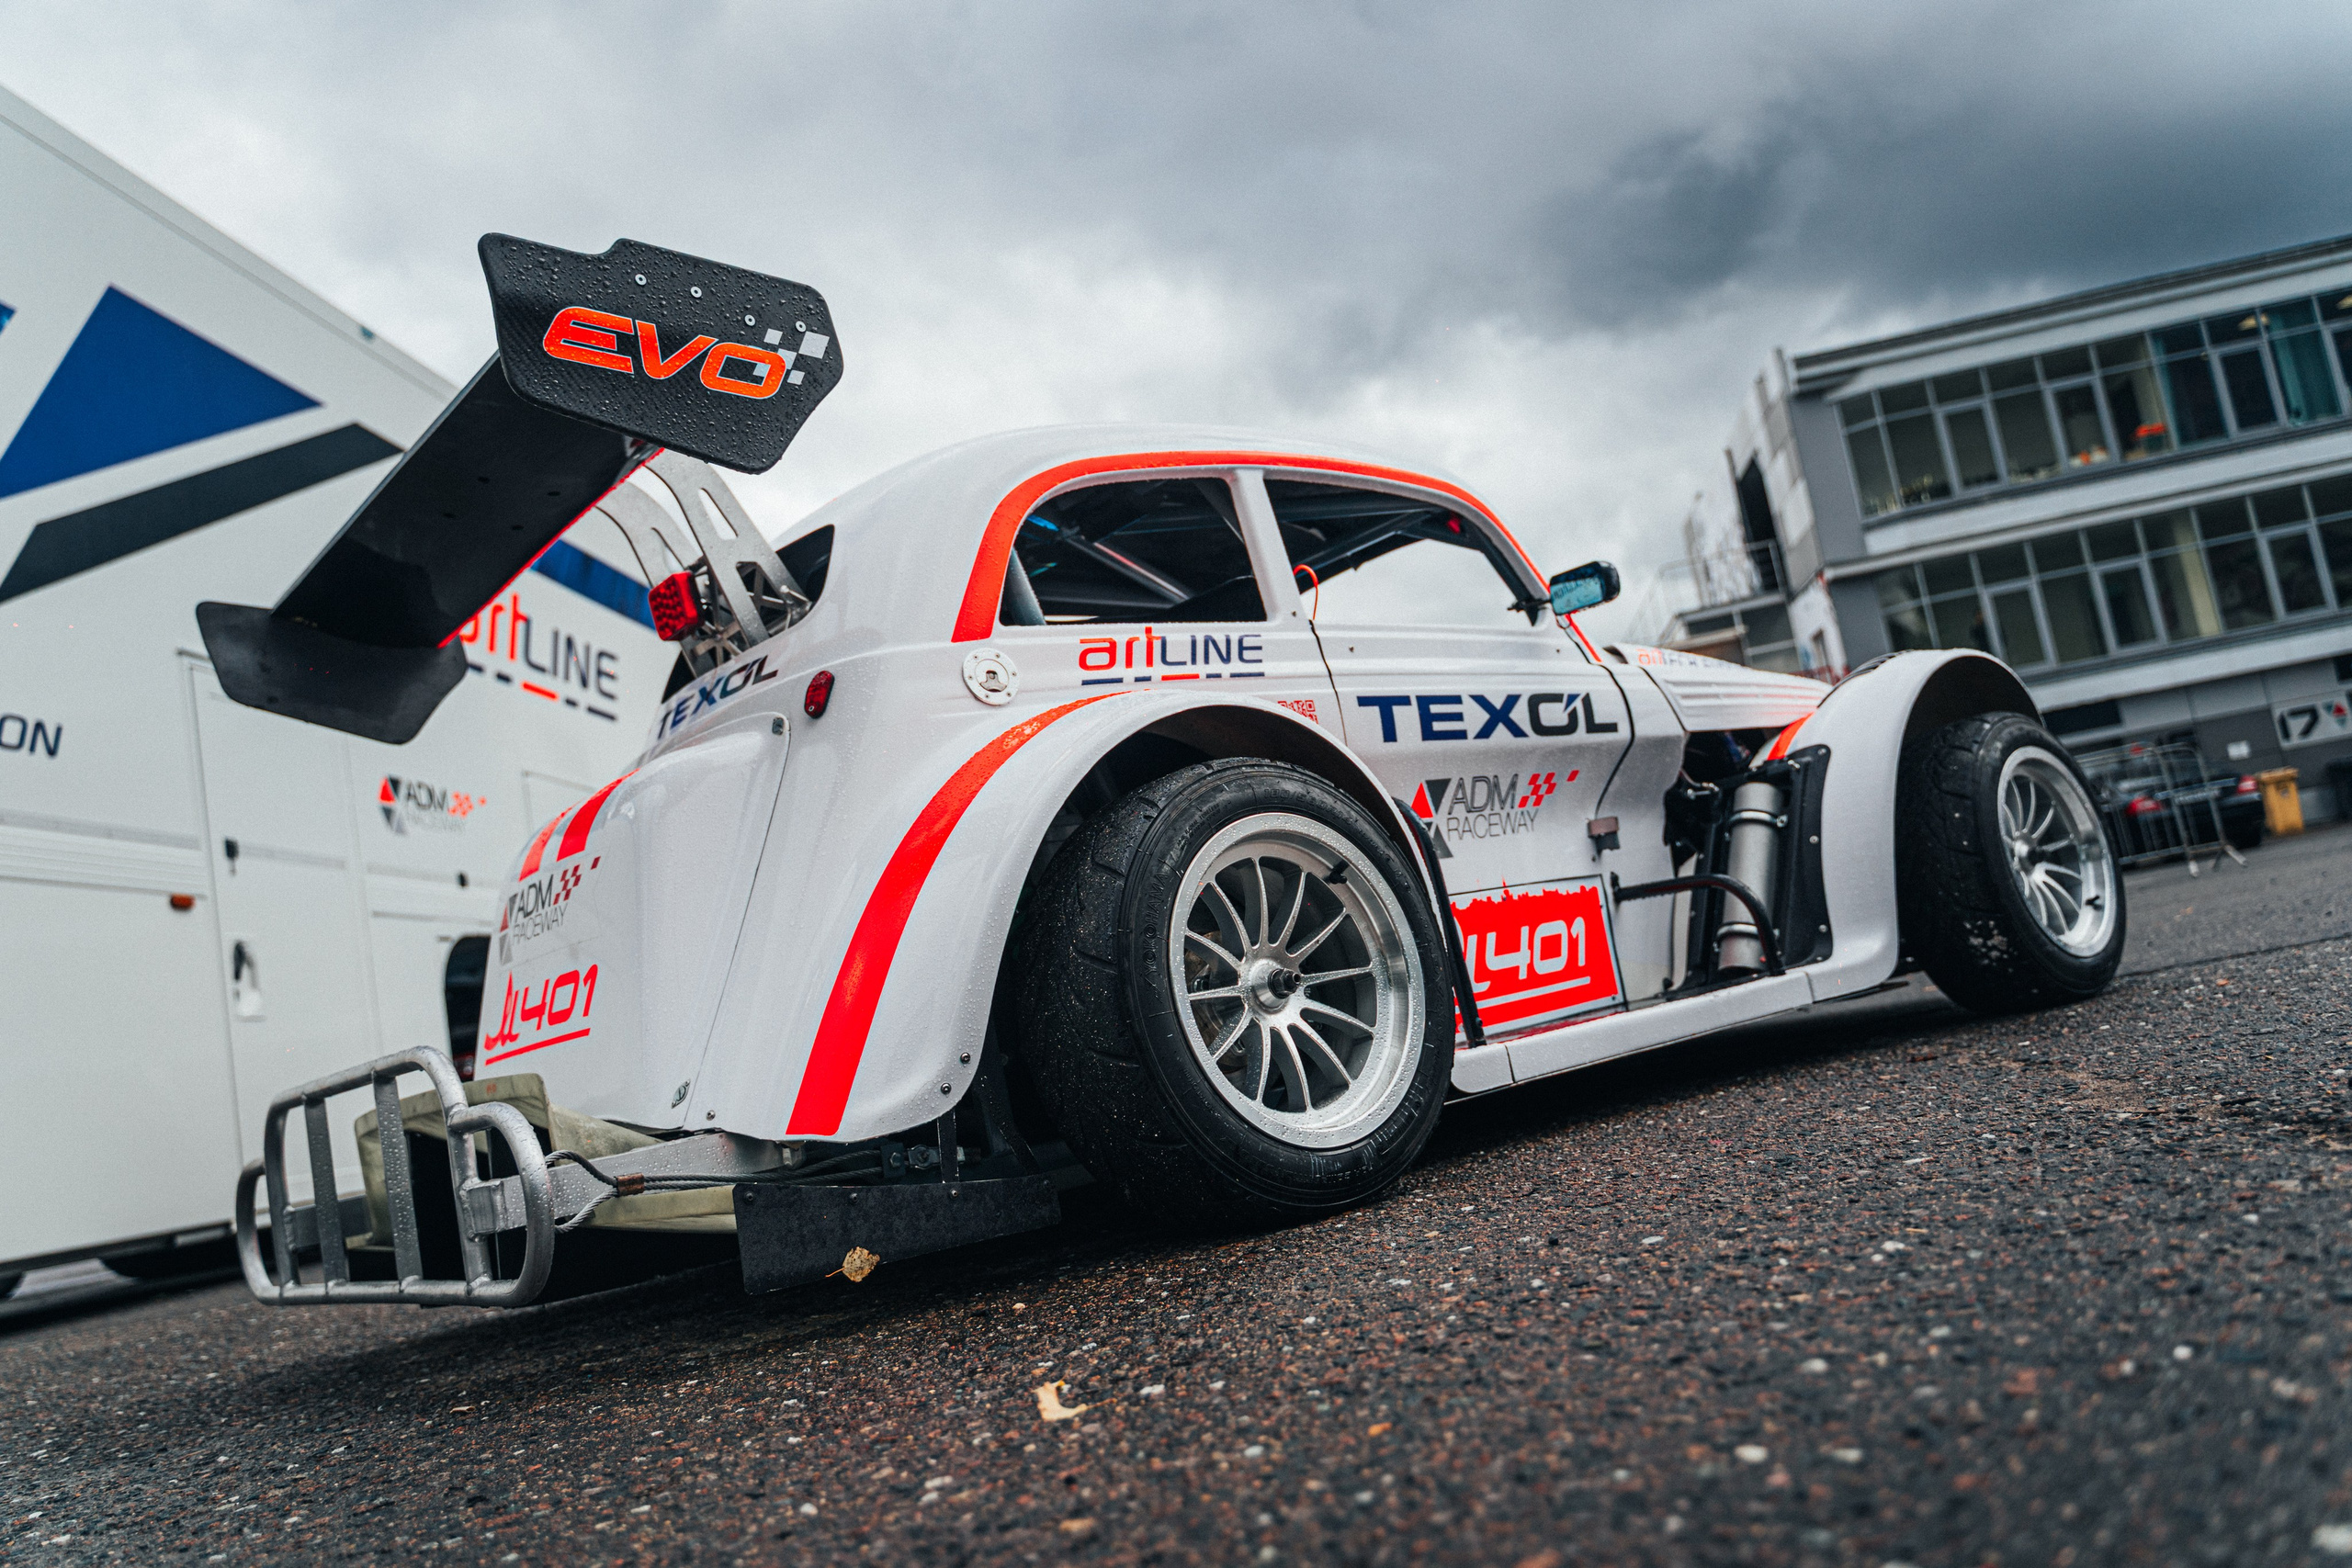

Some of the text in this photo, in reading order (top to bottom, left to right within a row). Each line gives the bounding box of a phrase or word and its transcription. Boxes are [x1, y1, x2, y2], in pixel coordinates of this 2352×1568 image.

[542, 306, 787, 400] EVO
[658, 654, 779, 739] TEXOL
[1356, 693, 1619, 742] TEXOL
[405, 780, 448, 811] ADM
[1447, 773, 1519, 815] ADM
[1446, 808, 1539, 841] RACEWAY
[515, 874, 554, 924] ADM
[512, 903, 569, 946] RACEWAY
